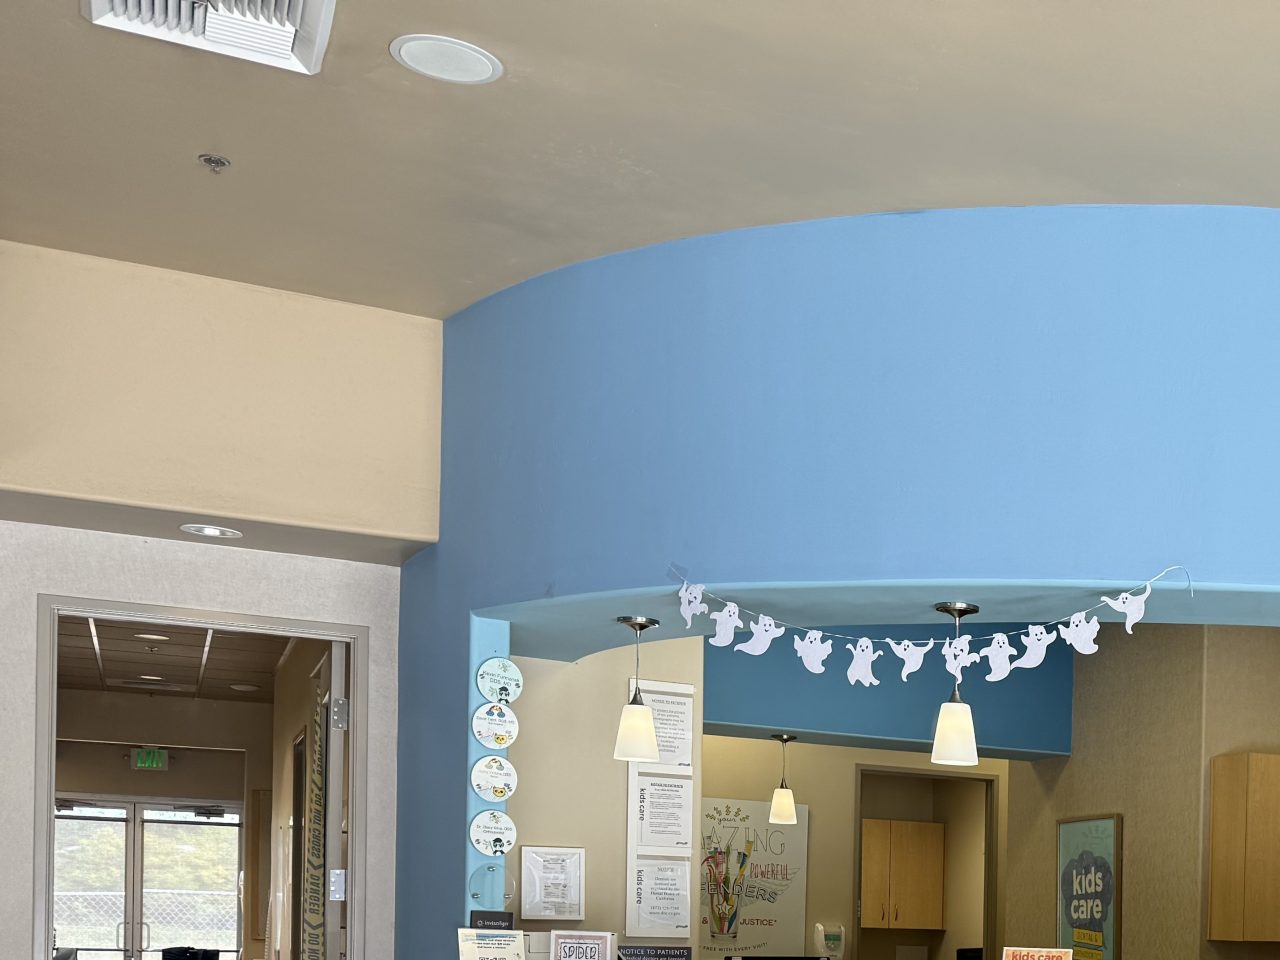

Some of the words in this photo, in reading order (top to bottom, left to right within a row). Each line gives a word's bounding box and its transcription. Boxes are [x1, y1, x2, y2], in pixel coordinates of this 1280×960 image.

[717, 817, 736, 826] your
[636, 870, 644, 886] kids
[750, 862, 790, 880] POWERFUL
[1072, 866, 1103, 896] kids
[1070, 898, 1102, 920] care
[562, 945, 597, 960] SPIDER
